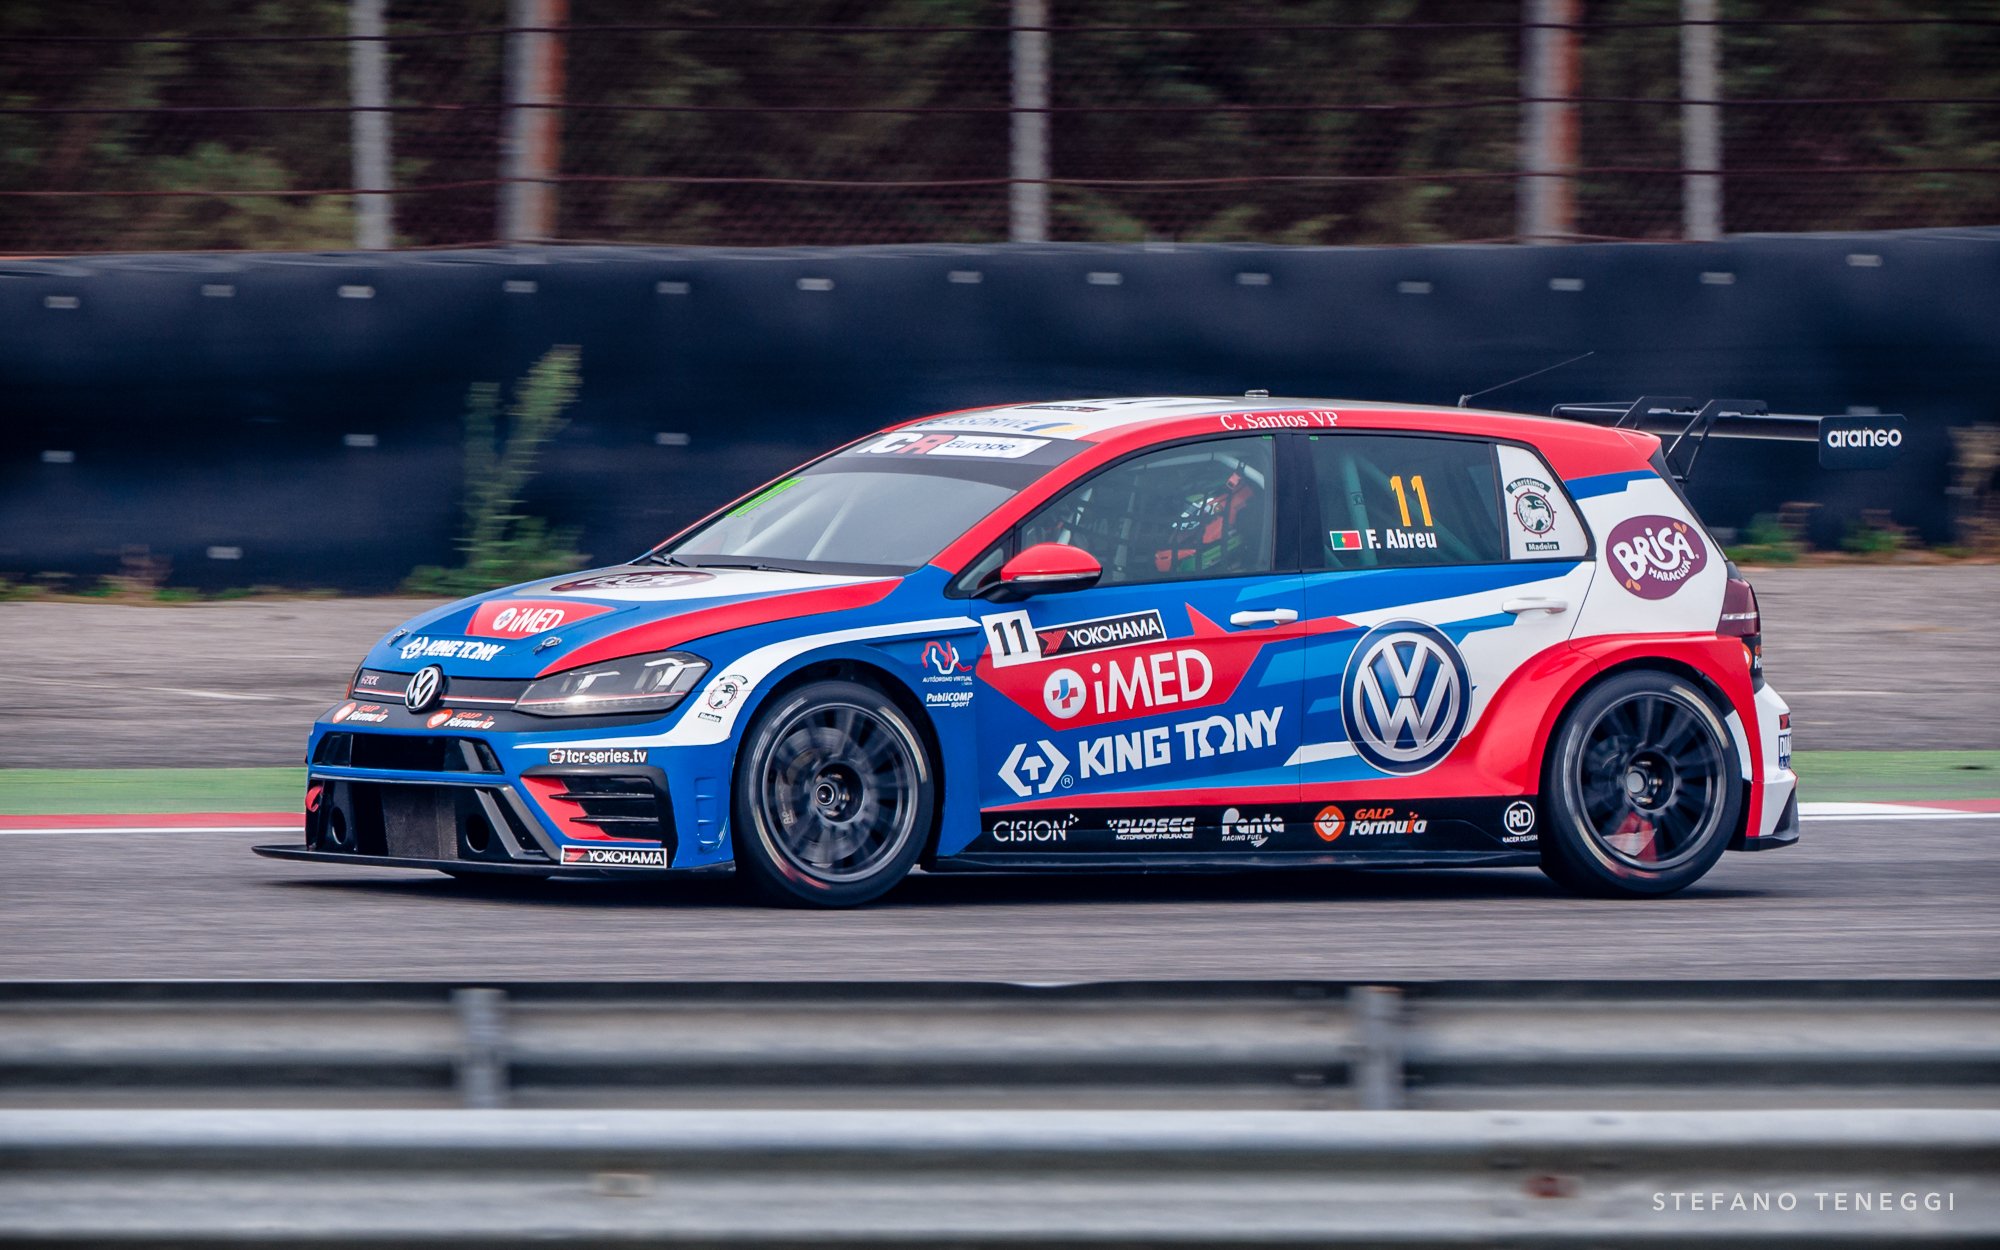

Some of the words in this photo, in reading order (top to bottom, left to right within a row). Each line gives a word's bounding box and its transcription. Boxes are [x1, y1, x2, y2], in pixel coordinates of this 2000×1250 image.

[1220, 415, 1243, 430] C.
[1243, 413, 1308, 429] Santos
[1309, 411, 1338, 427] VP
[944, 438, 1016, 452] Europe
[1390, 475, 1433, 527] 11
[1365, 529, 1381, 549] F.
[1386, 528, 1437, 549] Abreu
[1528, 543, 1558, 551] Madeira
[508, 608, 565, 633] iMED
[992, 619, 1029, 656] 11
[1067, 618, 1161, 647] YOKOHAMA
[422, 640, 464, 656] KING
[456, 641, 506, 661] TONY
[1092, 649, 1213, 714] iMED
[1079, 726, 1171, 778] KING
[1176, 706, 1283, 761] TONY
[567, 749, 647, 763] tcr-series.tv
[1222, 808, 1285, 834] Panta
[1355, 808, 1394, 819] GALP
[1509, 809, 1532, 827] RD
[993, 820, 1067, 842] CISION
[1222, 834, 1245, 842] RACING
[588, 850, 664, 865] YOKOHAMA
